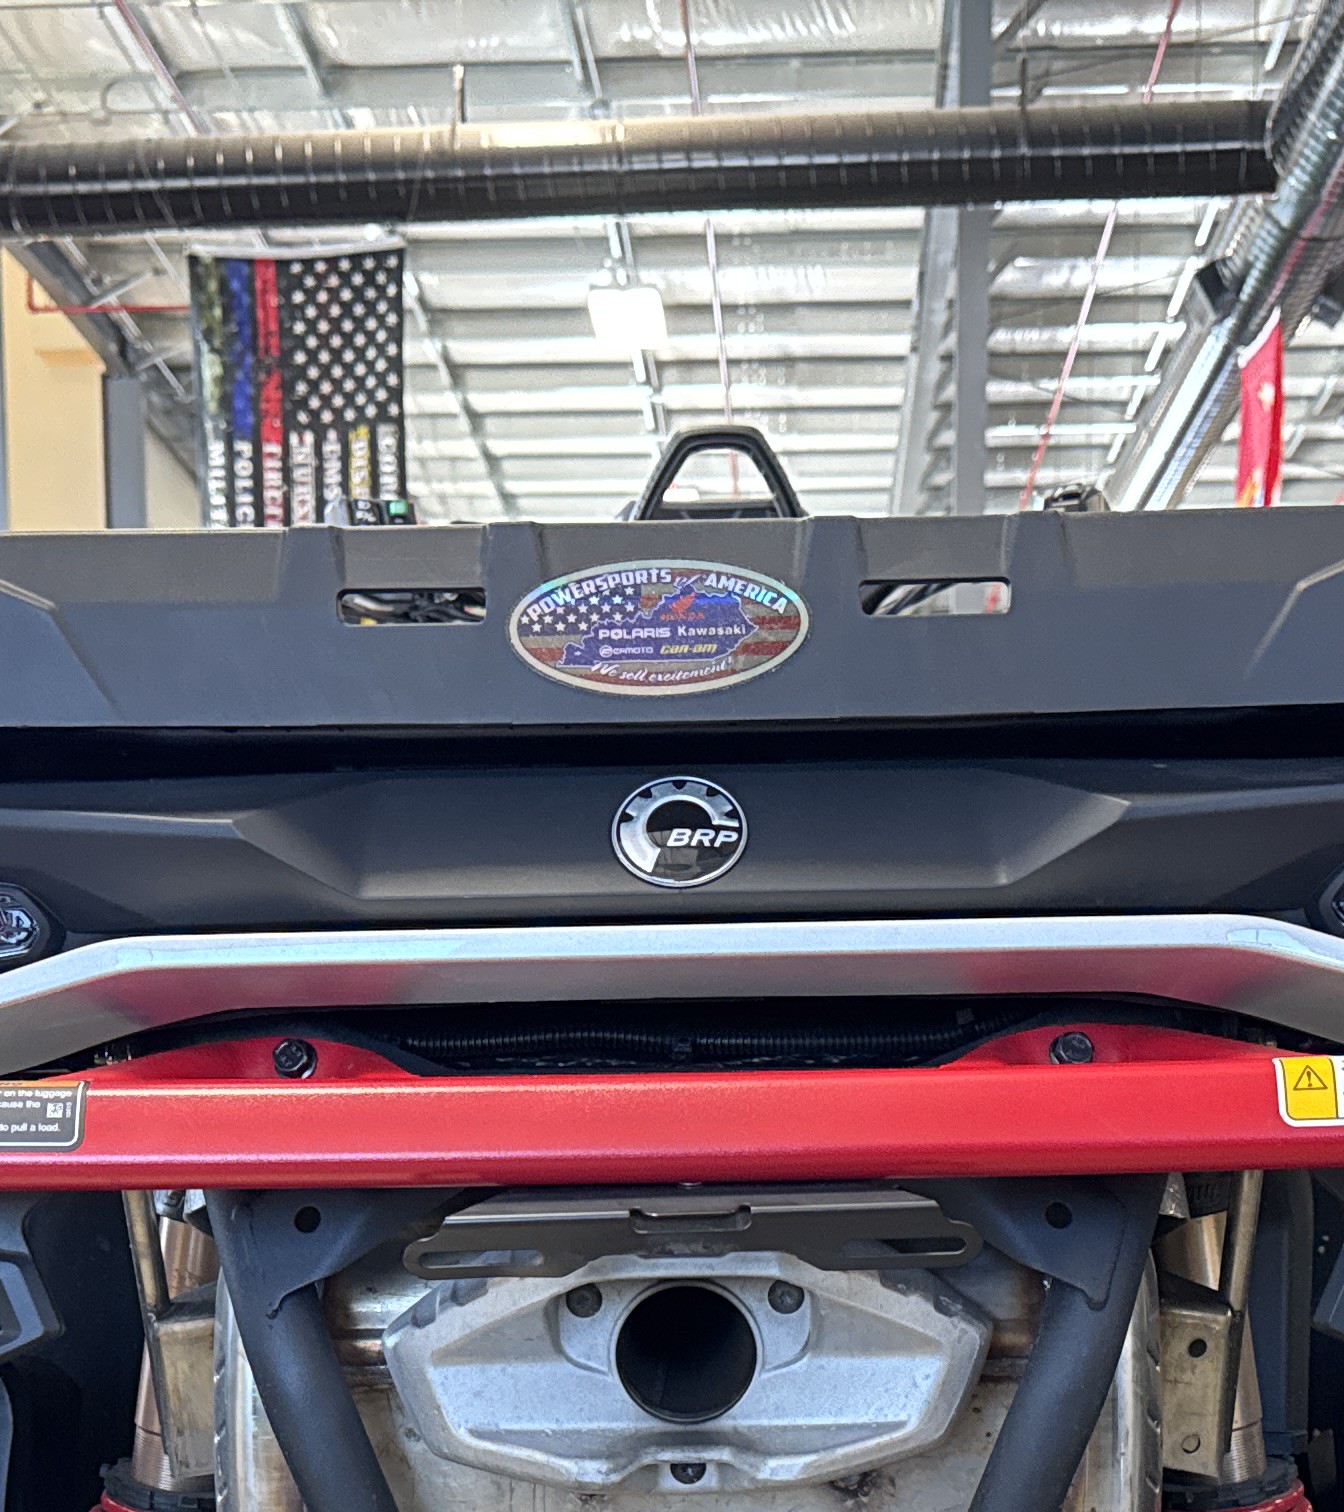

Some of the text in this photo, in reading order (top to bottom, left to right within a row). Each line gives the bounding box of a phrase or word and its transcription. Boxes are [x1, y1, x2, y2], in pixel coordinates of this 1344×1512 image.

[207, 440, 228, 528] MILIT
[233, 440, 255, 528] POLIC
[262, 442, 284, 527] FIREF
[292, 446, 315, 524] NURS
[526, 568, 672, 621] POWERSPORTS
[704, 572, 788, 614] AMERICA
[598, 627, 671, 640] POLARIS
[677, 624, 746, 637] Kawasaki
[666, 828, 739, 847] BRP
[17, 1089, 33, 1097] the
[35, 1089, 73, 1099] luggage
[25, 1100, 41, 1108] the
[0, 1122, 9, 1132] to
[10, 1122, 28, 1134] pull
[29, 1124, 37, 1132] a
